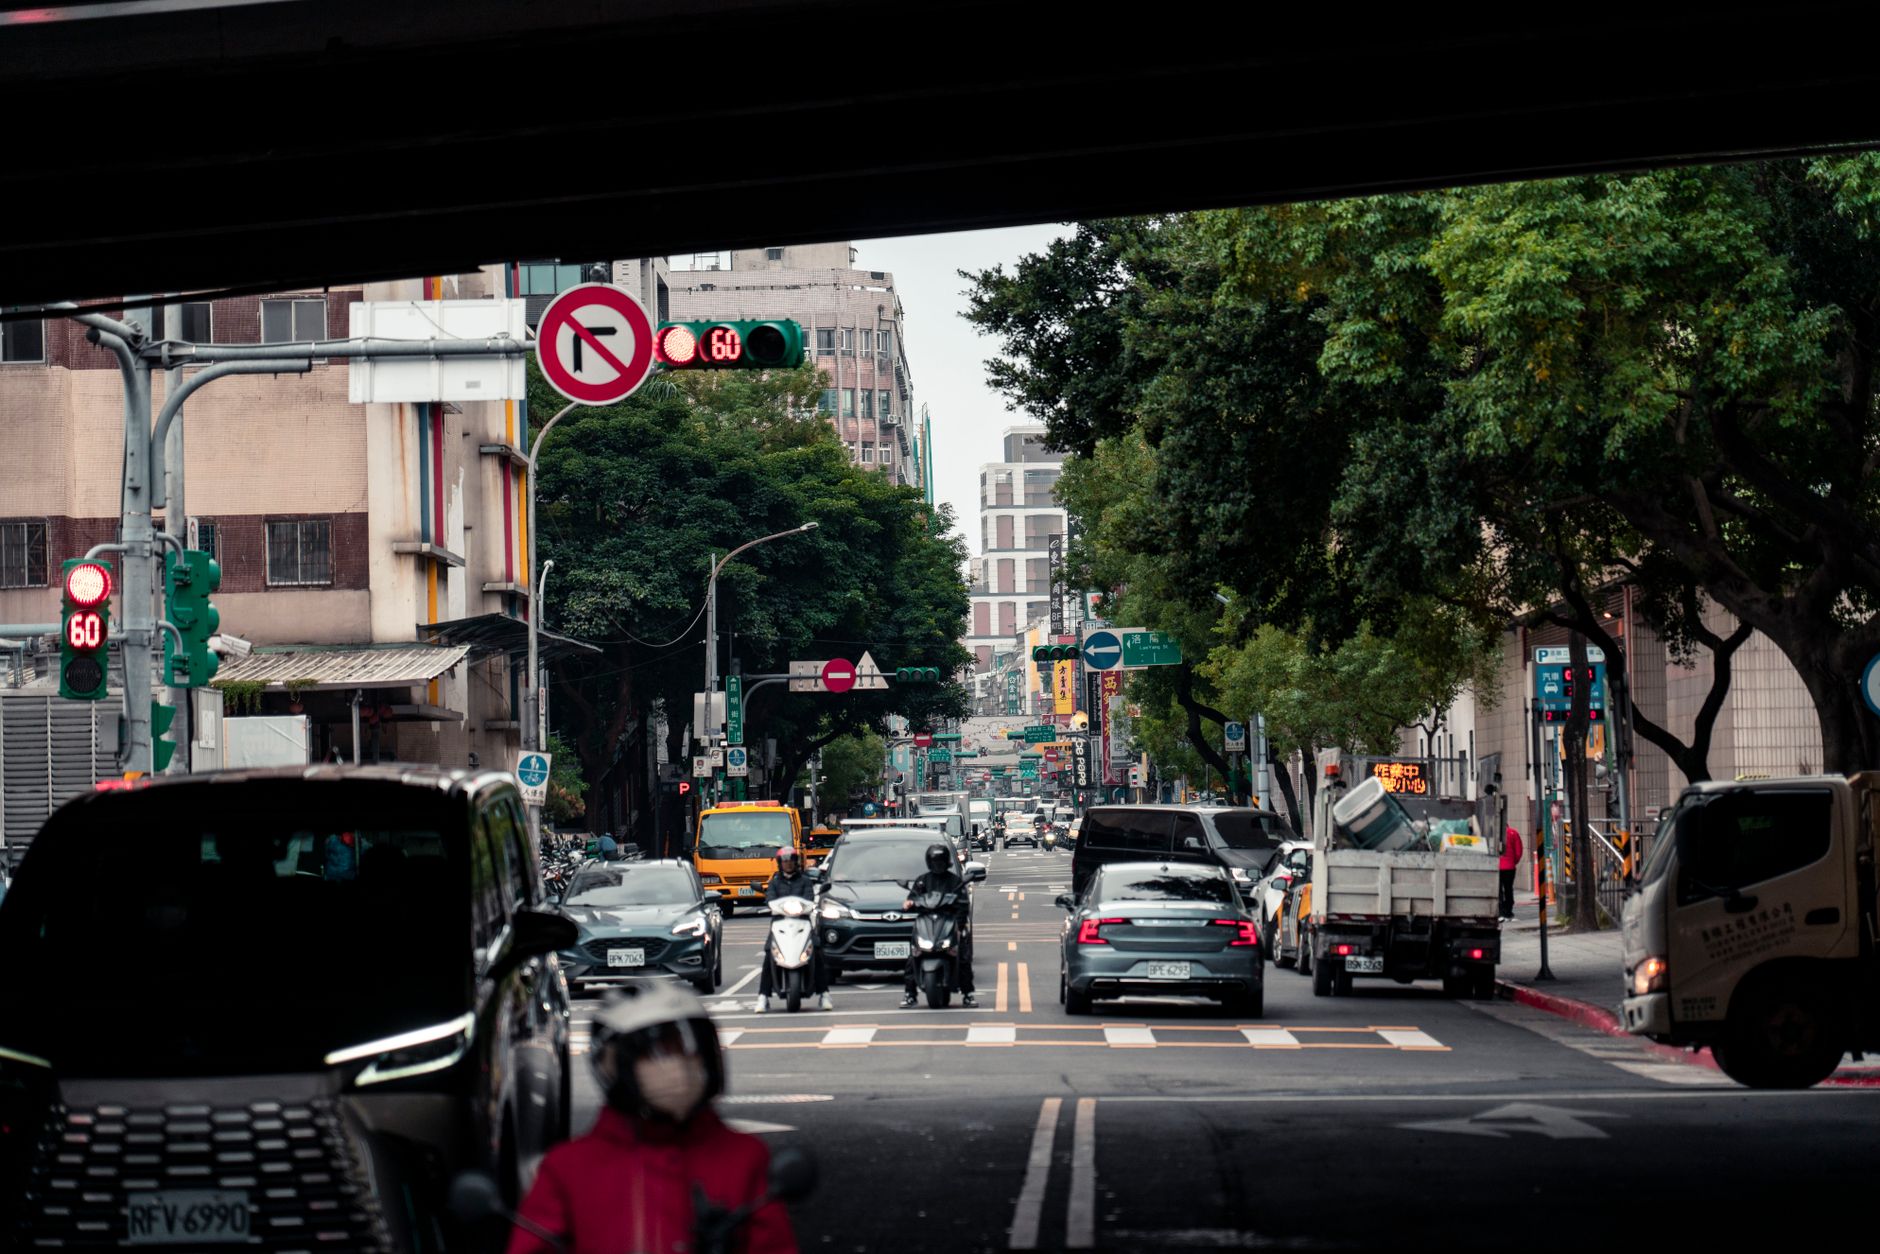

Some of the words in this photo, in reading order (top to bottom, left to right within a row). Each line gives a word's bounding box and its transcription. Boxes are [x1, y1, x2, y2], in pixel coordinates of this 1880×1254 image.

[711, 329, 741, 360] 60
[71, 614, 99, 648] 60
[1538, 649, 1549, 662] P
[679, 782, 690, 795] P
[130, 1203, 246, 1235] RFV-6990
